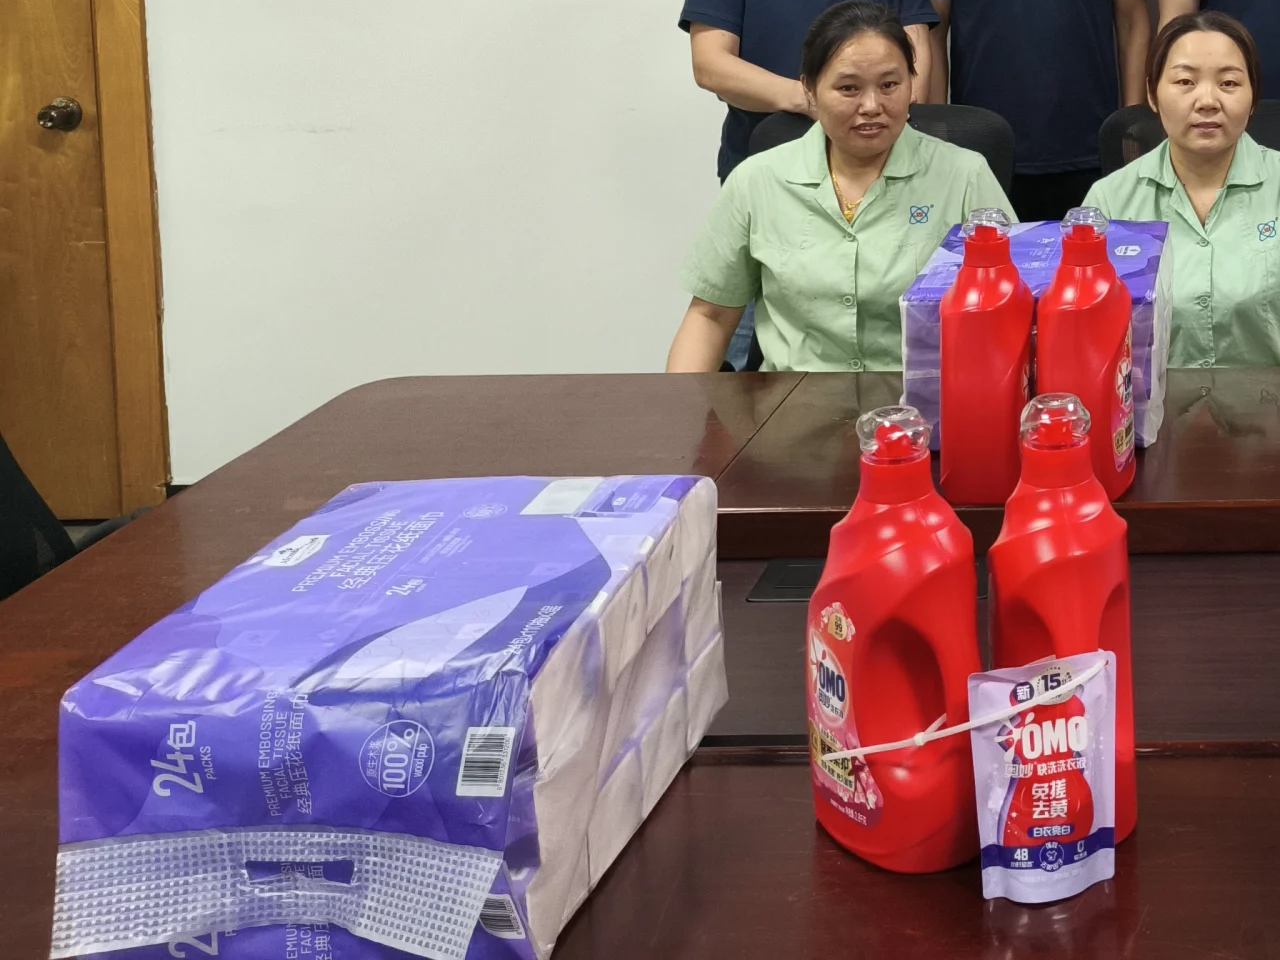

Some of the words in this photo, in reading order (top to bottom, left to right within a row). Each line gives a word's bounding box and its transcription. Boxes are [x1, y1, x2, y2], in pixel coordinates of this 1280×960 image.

[291, 555, 342, 592] PREMIUM
[339, 509, 401, 558] EMBOSSING
[330, 548, 374, 578] FACIAL
[364, 520, 408, 550] TISSUE
[338, 511, 445, 590] 经典压花纸面巾
[819, 661, 845, 702] OMO
[1016, 685, 1030, 700] 新
[1041, 673, 1061, 691] 15
[258, 690, 279, 769] EMBOSSING
[272, 711, 289, 761] TISSUE
[415, 743, 430, 759] pulp
[1022, 715, 1088, 760] OMO
[150, 720, 204, 797] 24包
[200, 745, 217, 780] PACKS
[285, 693, 313, 816] 经典压花纸面巾
[366, 740, 383, 778] 原生木浆
[382, 728, 415, 791] 100%
[257, 771, 282, 817] PREMIUM
[273, 763, 292, 800] FACIAL
[1031, 779, 1067, 800] 免搓
[1032, 800, 1068, 819] 去黄
[1014, 848, 1029, 861] 48
